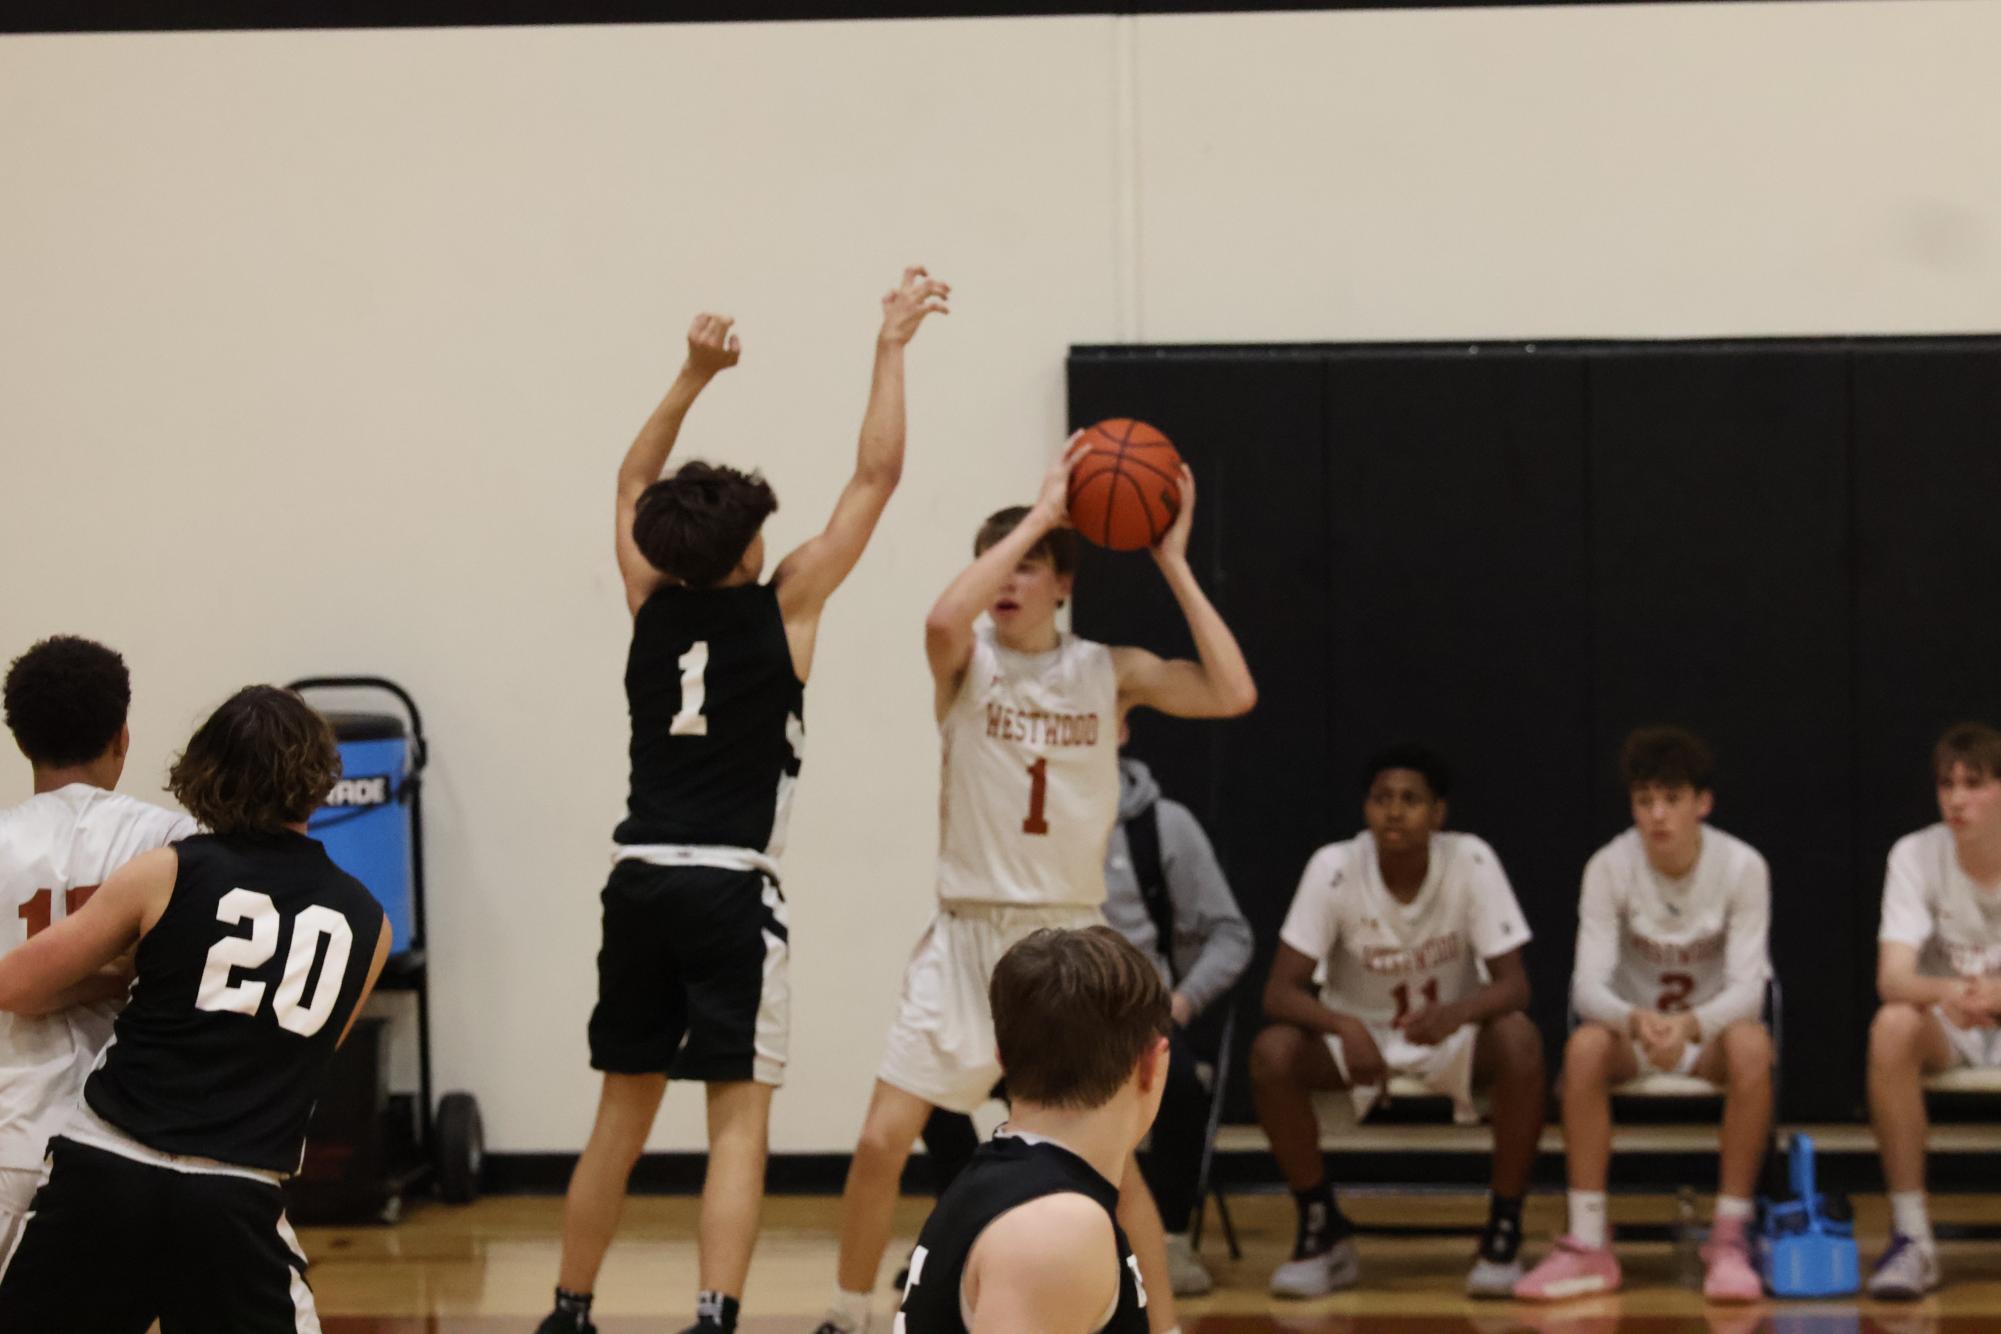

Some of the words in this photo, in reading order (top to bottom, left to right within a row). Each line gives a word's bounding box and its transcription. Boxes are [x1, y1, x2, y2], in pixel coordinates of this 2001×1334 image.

[669, 641, 708, 736] 1
[986, 702, 1098, 746] WESTWOOD
[1023, 757, 1047, 834] 1
[195, 887, 353, 1037] 20
[1657, 971, 1695, 1014] 2
